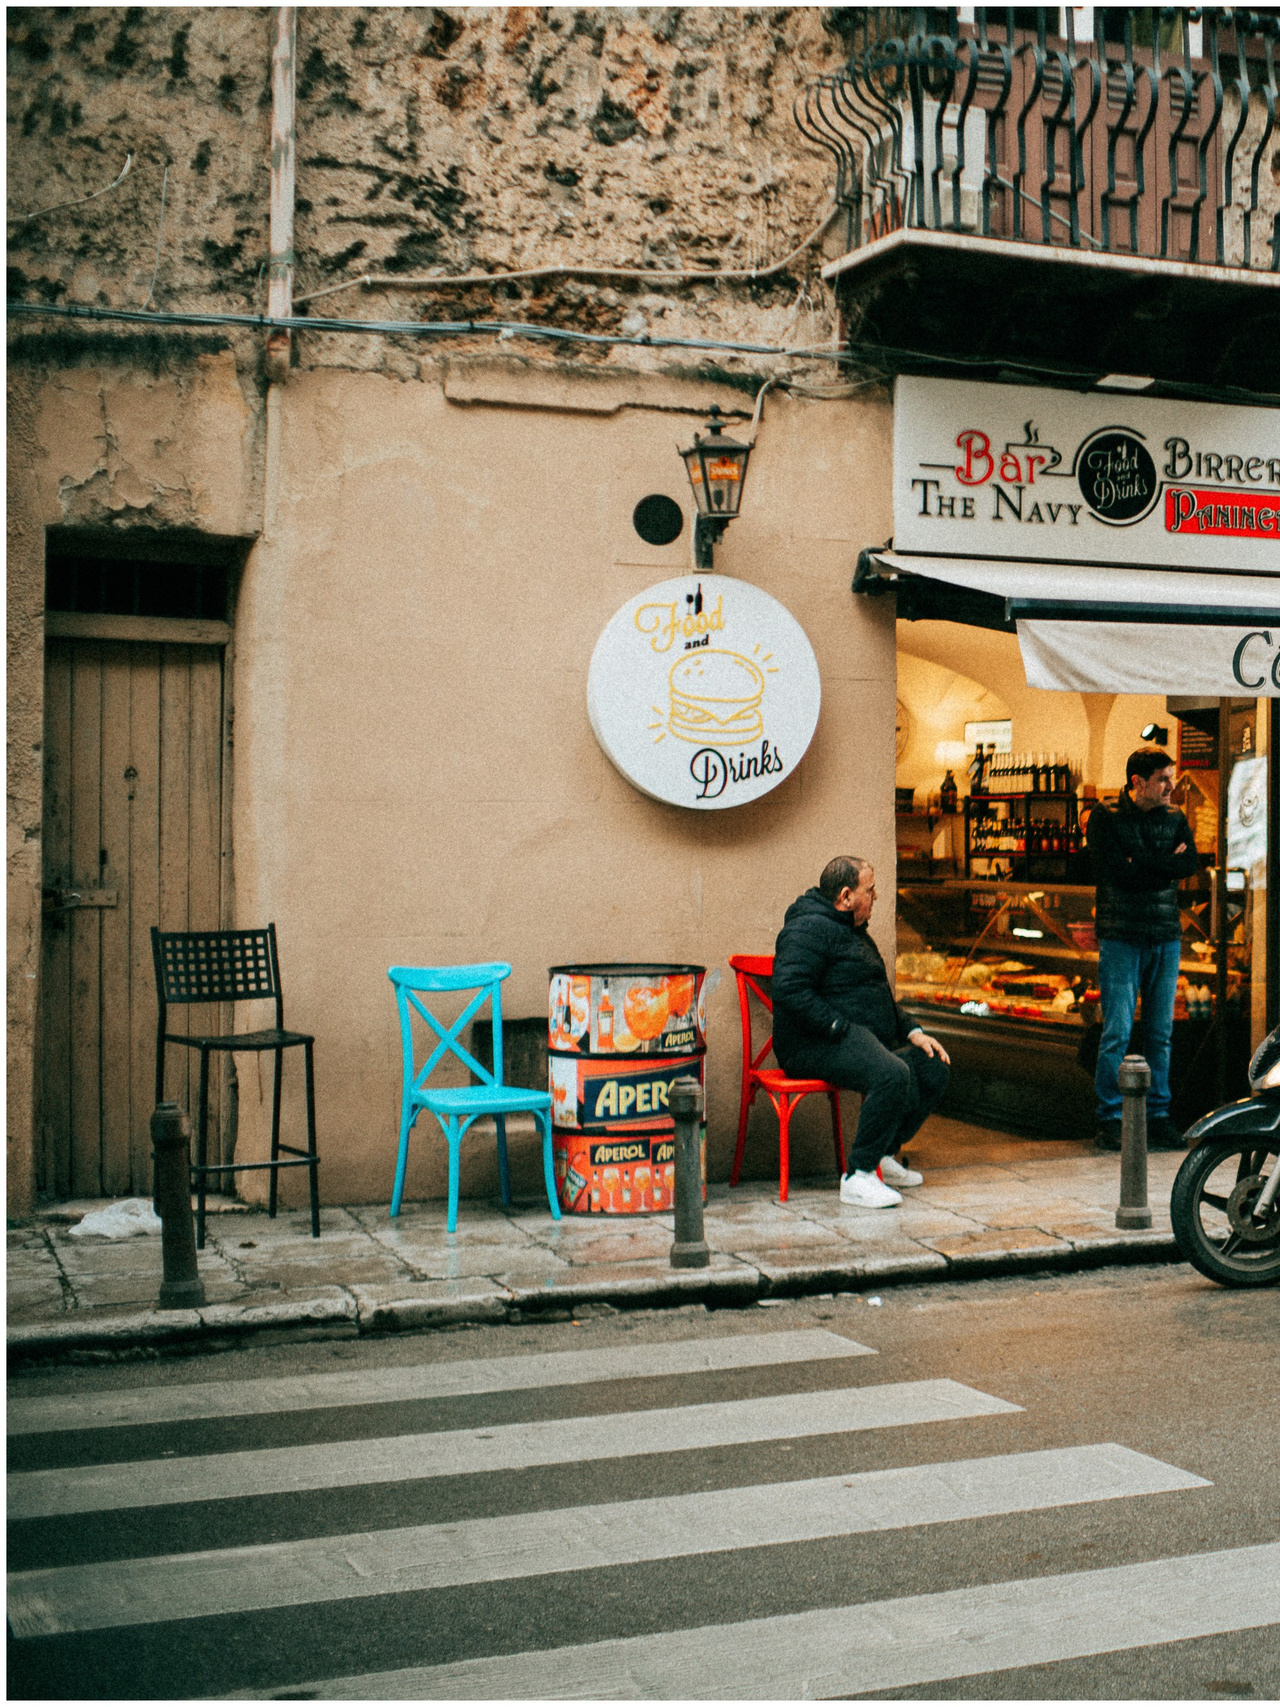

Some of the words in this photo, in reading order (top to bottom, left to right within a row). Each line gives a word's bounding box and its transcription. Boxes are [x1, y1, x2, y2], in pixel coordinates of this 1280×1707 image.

[955, 430, 1045, 486] Bar
[911, 479, 975, 518] THE
[991, 483, 1082, 524] NAVY
[1093, 473, 1148, 509] Drinks
[634, 594, 725, 652] Food
[684, 634, 710, 650] and
[690, 740, 783, 800] Drinks
[665, 1031, 695, 1048] APEROL
[594, 1080, 676, 1117] APER
[594, 1144, 646, 1163] APEROL
